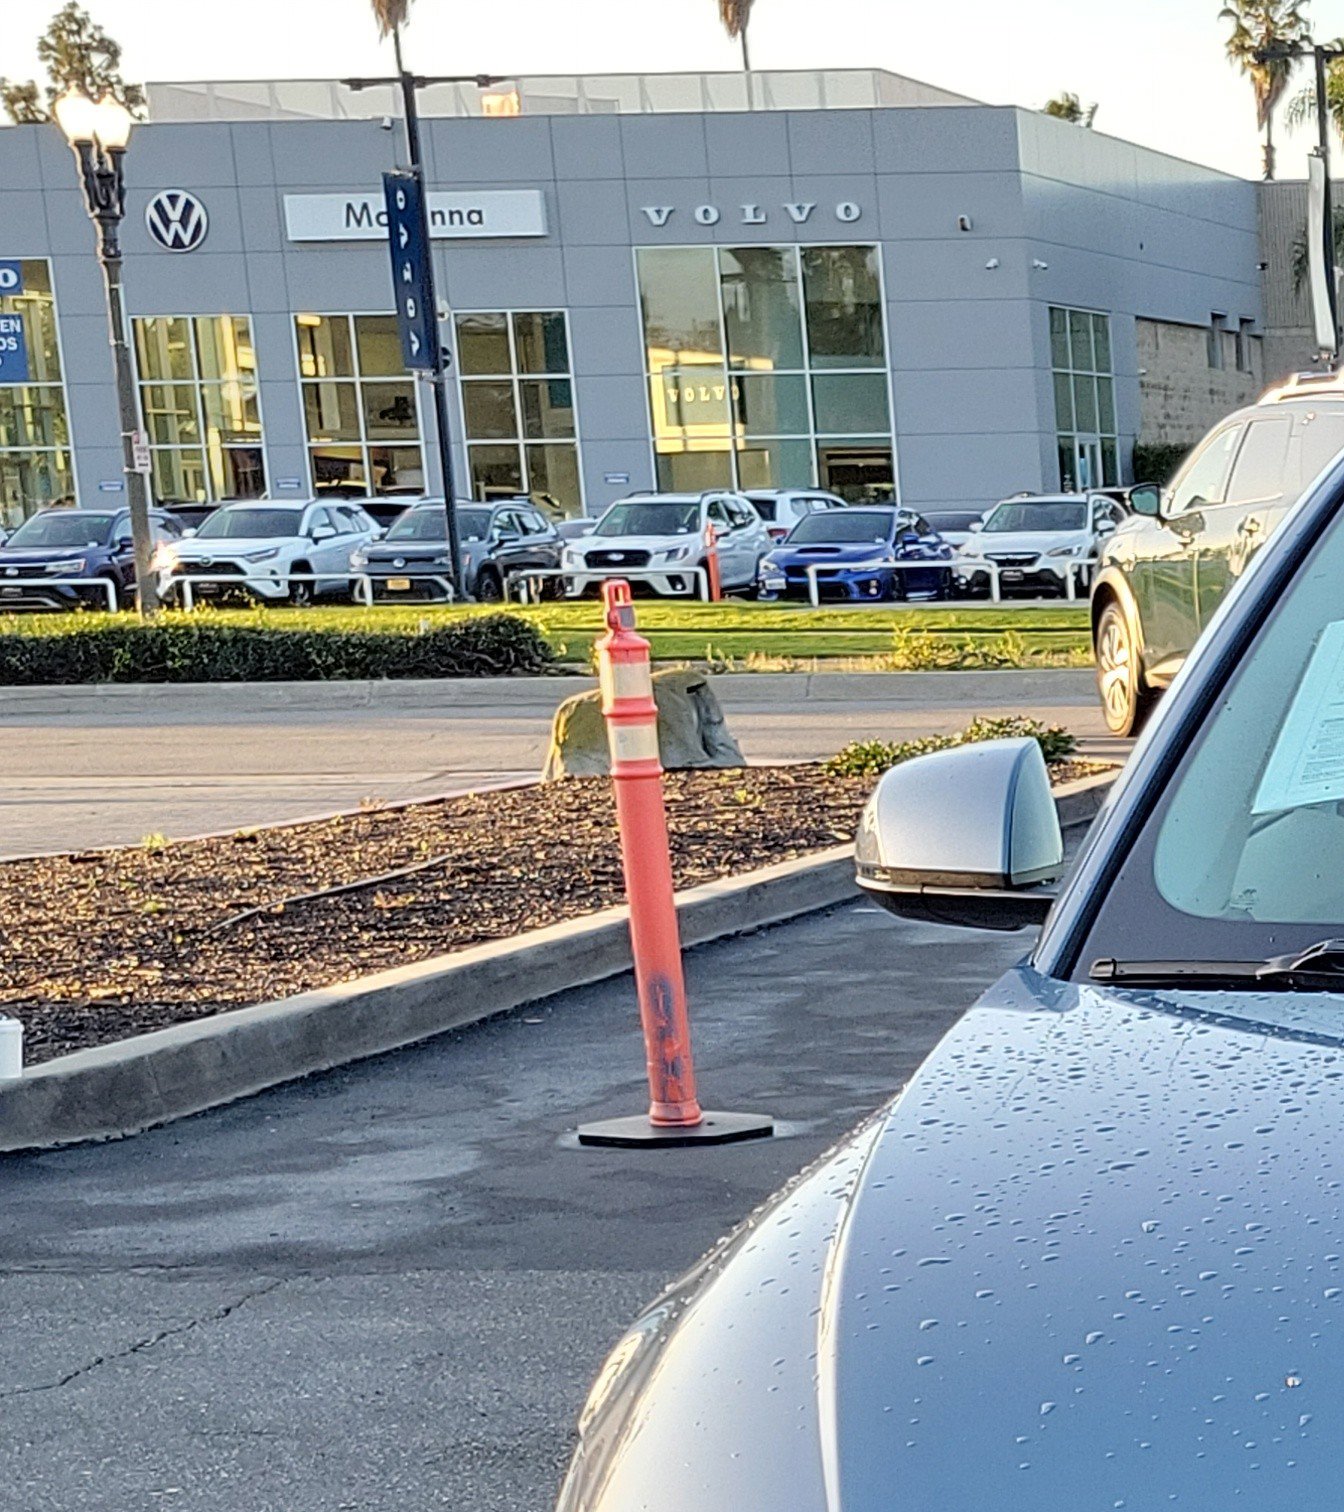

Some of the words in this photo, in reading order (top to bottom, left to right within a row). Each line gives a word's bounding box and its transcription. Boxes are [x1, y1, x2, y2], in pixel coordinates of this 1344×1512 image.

[345, 201, 484, 228] Mcnna
[642, 202, 862, 225] VOLVO
[667, 384, 741, 402] VOLVO
